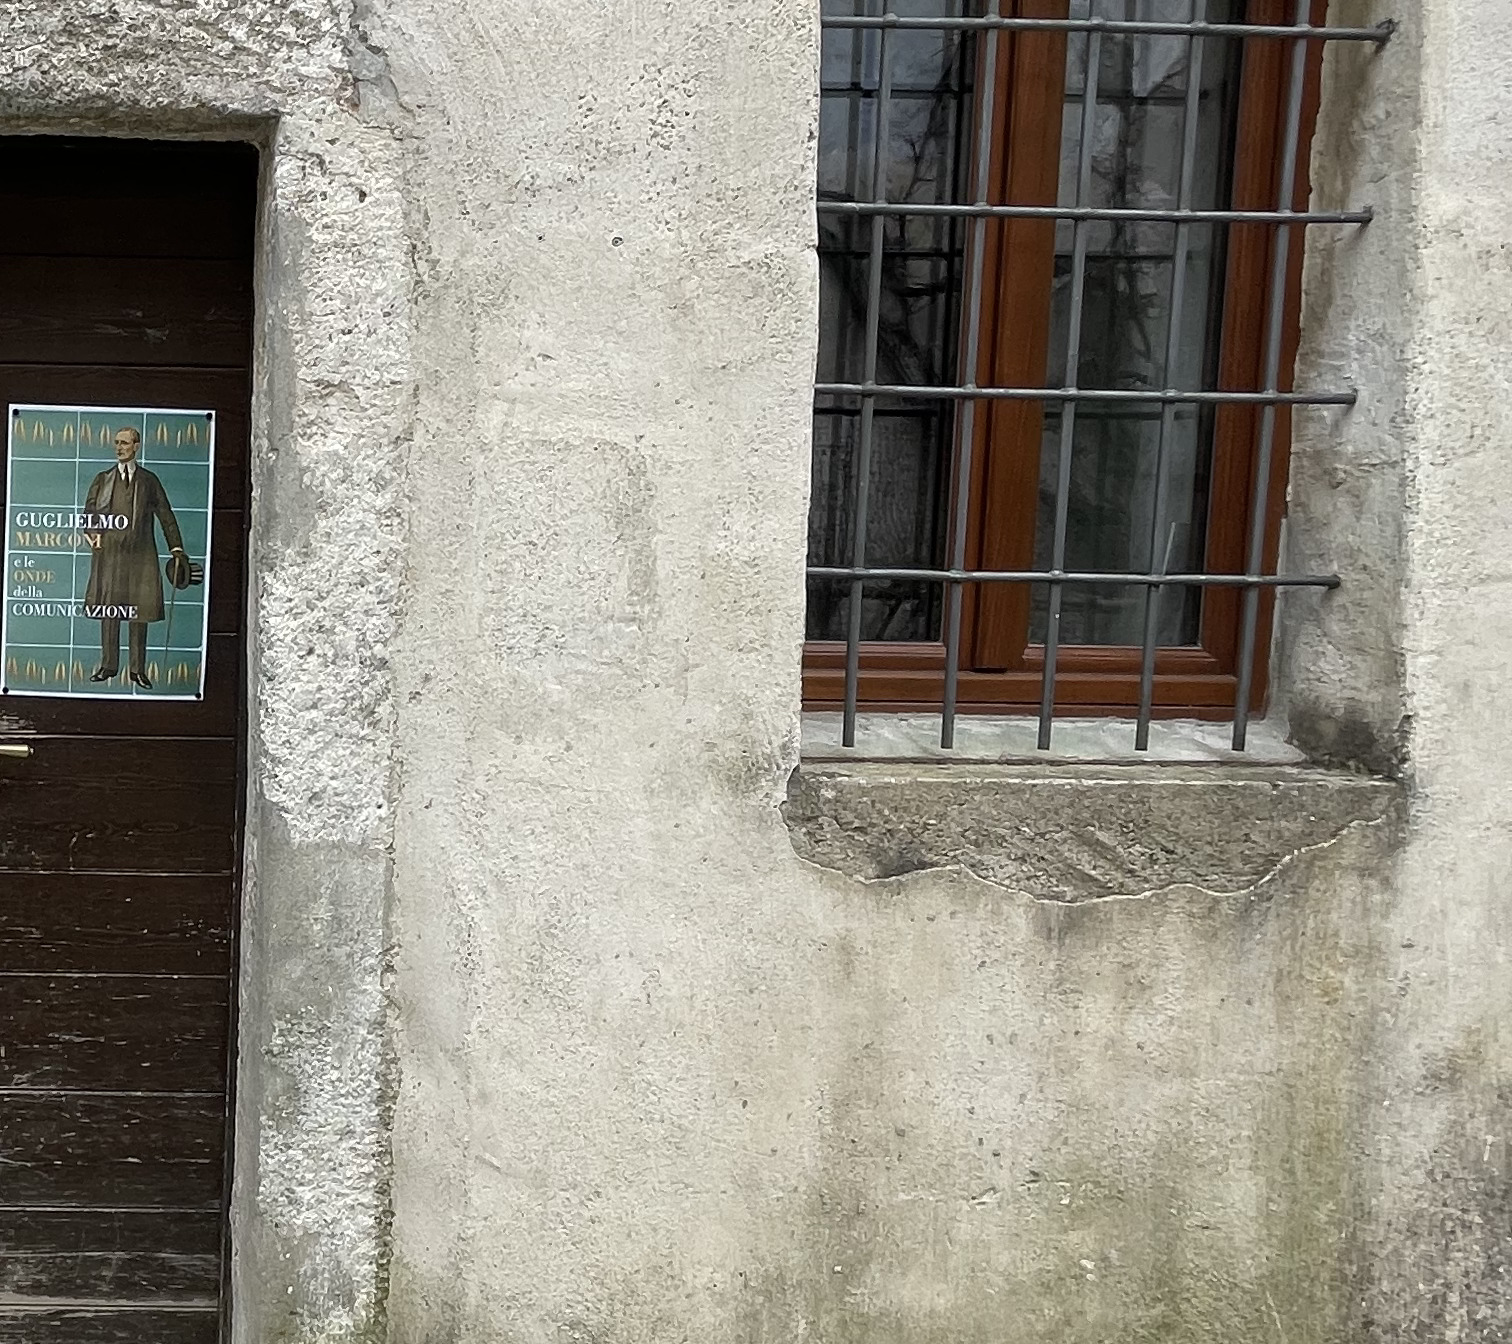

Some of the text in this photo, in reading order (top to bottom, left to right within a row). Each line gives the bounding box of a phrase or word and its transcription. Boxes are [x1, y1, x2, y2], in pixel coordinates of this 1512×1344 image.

[15, 512, 129, 530] GUGLIELMO
[13, 556, 36, 568] e le
[13, 570, 56, 583] ONDE
[12, 586, 43, 598] della
[12, 602, 138, 620] COMUNICAZIONE
